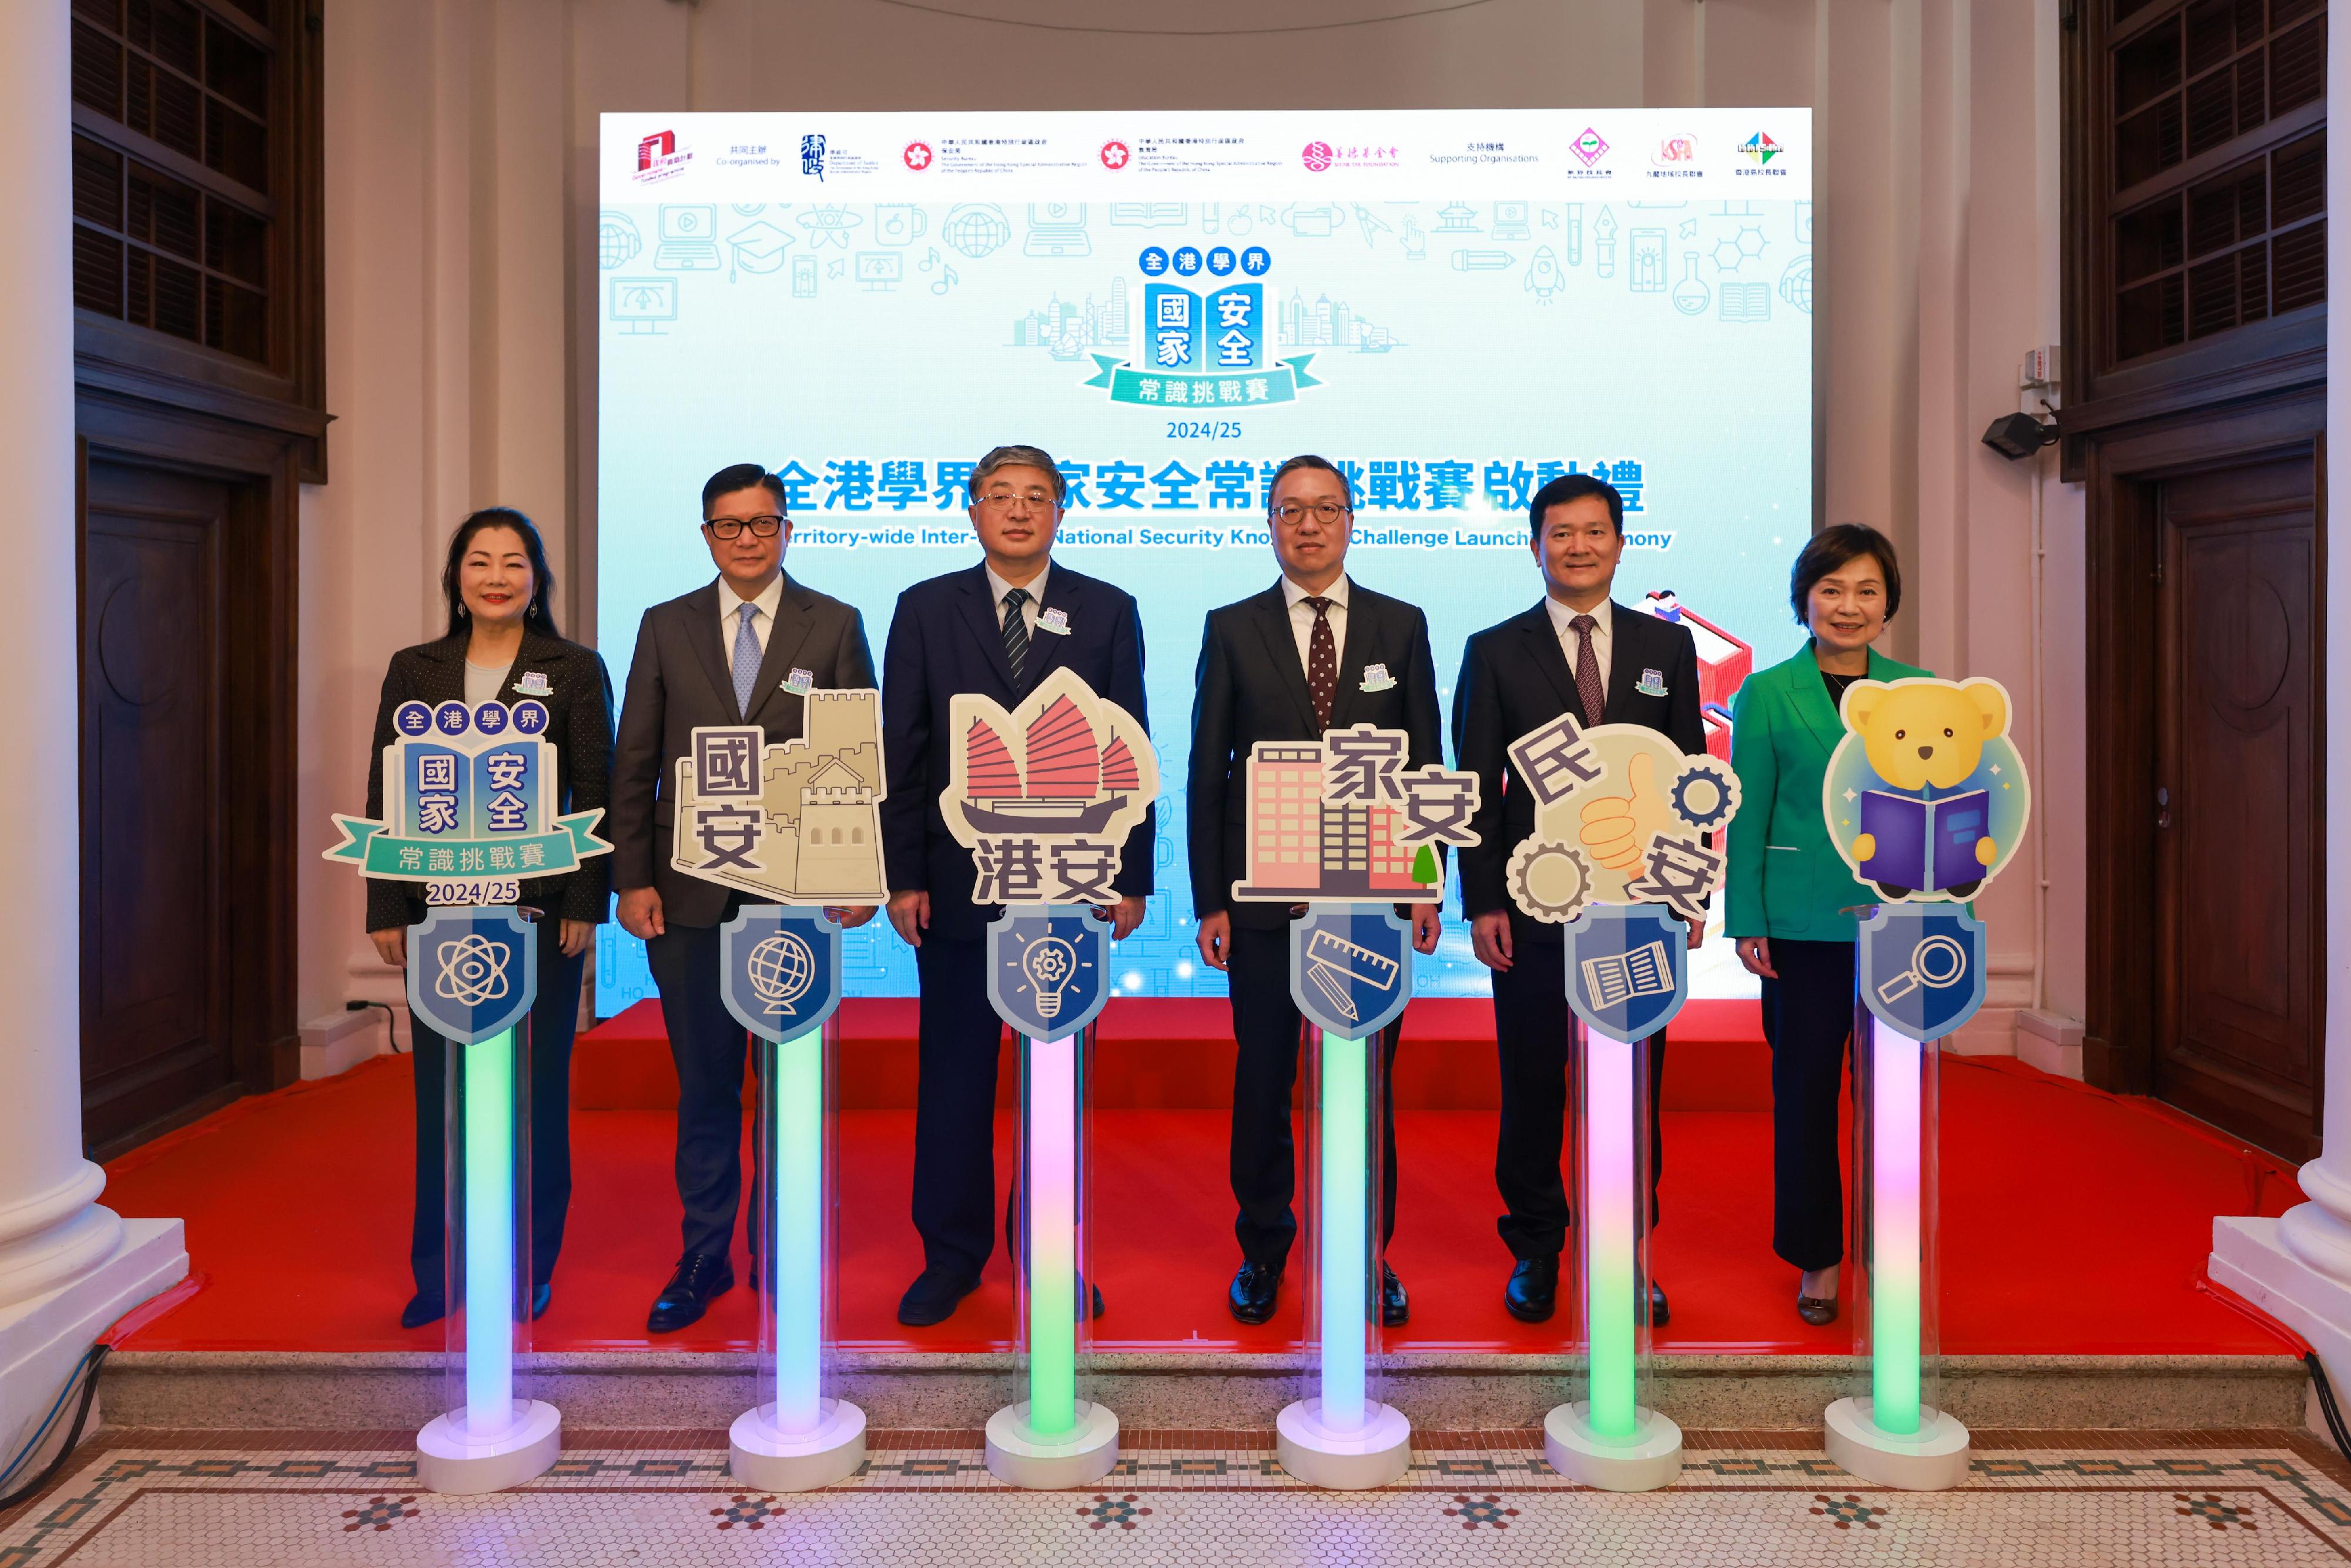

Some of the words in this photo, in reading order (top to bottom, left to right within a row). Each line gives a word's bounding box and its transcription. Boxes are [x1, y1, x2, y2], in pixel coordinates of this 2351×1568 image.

[731, 146, 767, 155] 共同主辦
[1467, 142, 1505, 152] 支持機構
[716, 158, 768, 167] Co-organised
[771, 158, 780, 167] by
[1430, 155, 1478, 165] Supporting
[1481, 155, 1539, 165] Organisations
[1146, 253, 1265, 271] 全港學界
[1156, 293, 1190, 366] 國家
[1217, 292, 1251, 366] 安全
[1139, 378, 1269, 403] 常識挑戰賽
[1167, 421, 1242, 441] 2024/25
[789, 529, 915, 547] rritory-wide
[1140, 530, 1224, 547] Security
[1352, 530, 1448, 548] Challenge
[1455, 531, 1532, 546] Launch
[405, 709, 539, 729] 全港學界
[418, 754, 458, 833] 國家
[487, 752, 527, 831] 安全
[696, 731, 762, 869] 國安
[399, 843, 545, 872] 常識挑戰賽
[977, 839, 1116, 900] 港安
[429, 882, 517, 903] 2024/25
